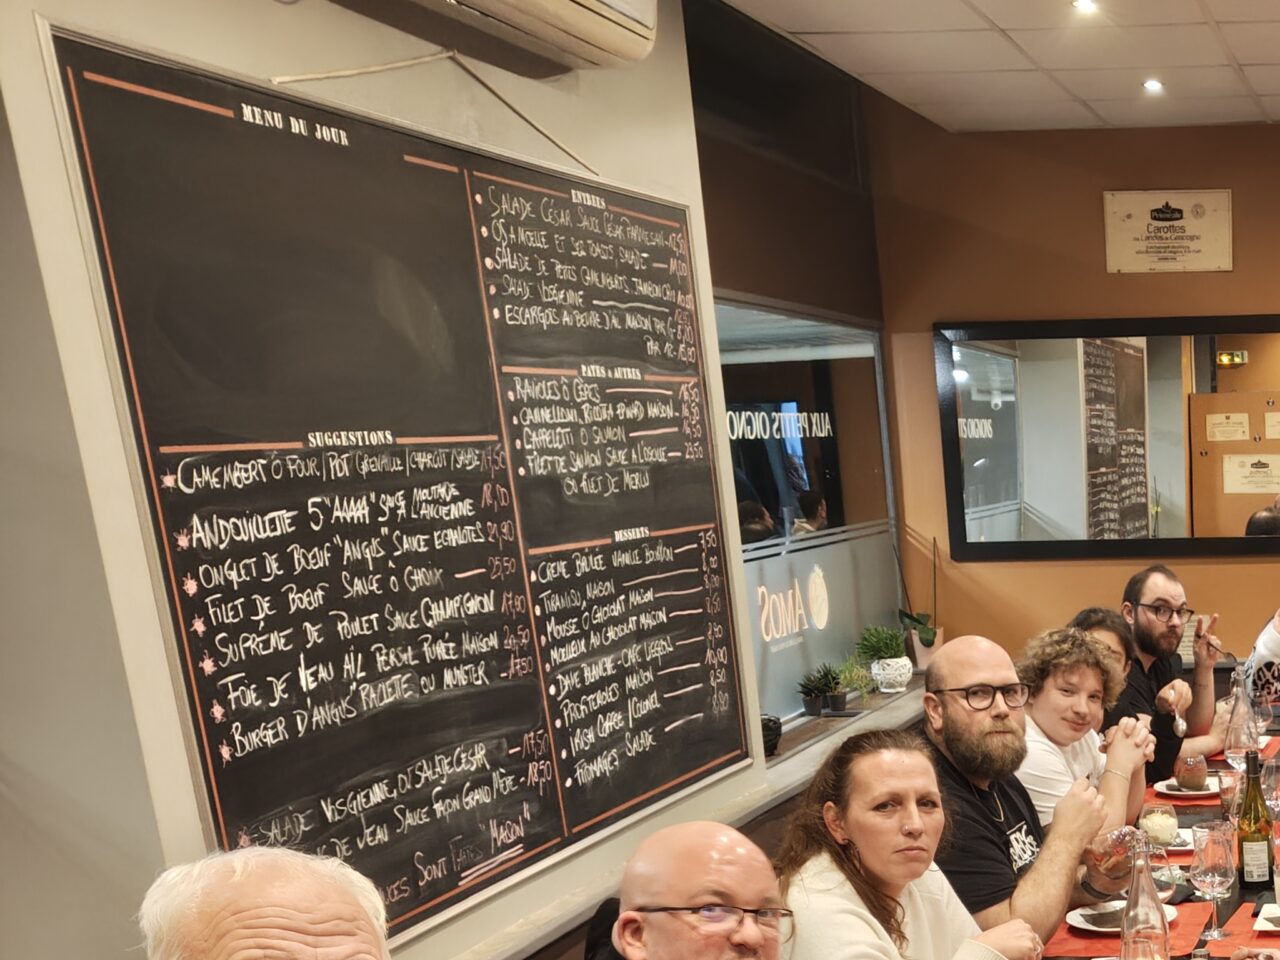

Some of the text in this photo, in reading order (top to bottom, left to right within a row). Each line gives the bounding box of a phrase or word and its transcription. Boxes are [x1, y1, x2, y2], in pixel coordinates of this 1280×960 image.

[241, 103, 349, 146] MENU DU JOUR
[488, 185, 536, 220] SALADE
[577, 207, 600, 233] SAUCE
[620, 217, 664, 246] PARMESAN
[1146, 223, 1186, 234] Carottes
[491, 219, 508, 246] OS
[518, 226, 549, 249] MOELLE
[554, 234, 566, 253] ET
[494, 246, 532, 272] SALADE
[535, 254, 549, 276] DE
[502, 274, 534, 300] SALADE
[505, 305, 559, 330] ESCARGOTS
[562, 311, 573, 326] AU
[613, 366, 642, 380] AUTRES
[647, 399, 673, 420] MAISON
[307, 430, 394, 448] SUGGESTIONS
[177, 457, 267, 495] CAMEMBERT
[286, 454, 320, 479] FOUR
[356, 448, 404, 480] GRENAILLE
[525, 451, 553, 476] FILET
[555, 453, 567, 474] DE
[563, 477, 578, 496] OU
[604, 472, 619, 497] DE
[191, 509, 299, 550] ANDOUILLETTE
[614, 526, 650, 543] DESSERTS
[199, 557, 256, 591] ONGLET
[261, 552, 284, 582] DE
[287, 543, 332, 575] BOEUF
[392, 530, 430, 556] SAUCE
[204, 593, 245, 626] FILET
[250, 595, 277, 621] DE
[281, 583, 330, 615] BOEUF
[341, 571, 383, 599] SAUCE
[404, 561, 444, 592] CHOIX
[488, 556, 516, 580] 25,50
[586, 578, 615, 600] MAISON
[302, 589, 495, 649] DE POULET SAUCE CHAMPIGNON
[546, 617, 580, 642] MOUSSE
[591, 594, 626, 625] CHOCOLAT
[628, 588, 654, 608] MAISON
[550, 607, 668, 667] MOELLEUX AU CHOCOLAT MAISON
[217, 672, 262, 711] FOIE
[266, 671, 292, 707] DE
[298, 651, 334, 693] VEAU
[371, 642, 420, 673] PERSIL
[461, 629, 499, 658] MAISON
[230, 716, 289, 758] BURGER
[359, 673, 414, 711] RACLETTE
[420, 673, 435, 694] OU
[443, 660, 490, 691] MUNSTER
[569, 727, 595, 760] IRISH
[597, 709, 625, 738] COFFEE
[625, 727, 657, 757] SALADE
[414, 753, 453, 788] SALADE
[356, 813, 389, 850] VEAU
[393, 804, 431, 834] SAUCE
[462, 782, 492, 811] GRAND
[414, 851, 448, 887] SONT
